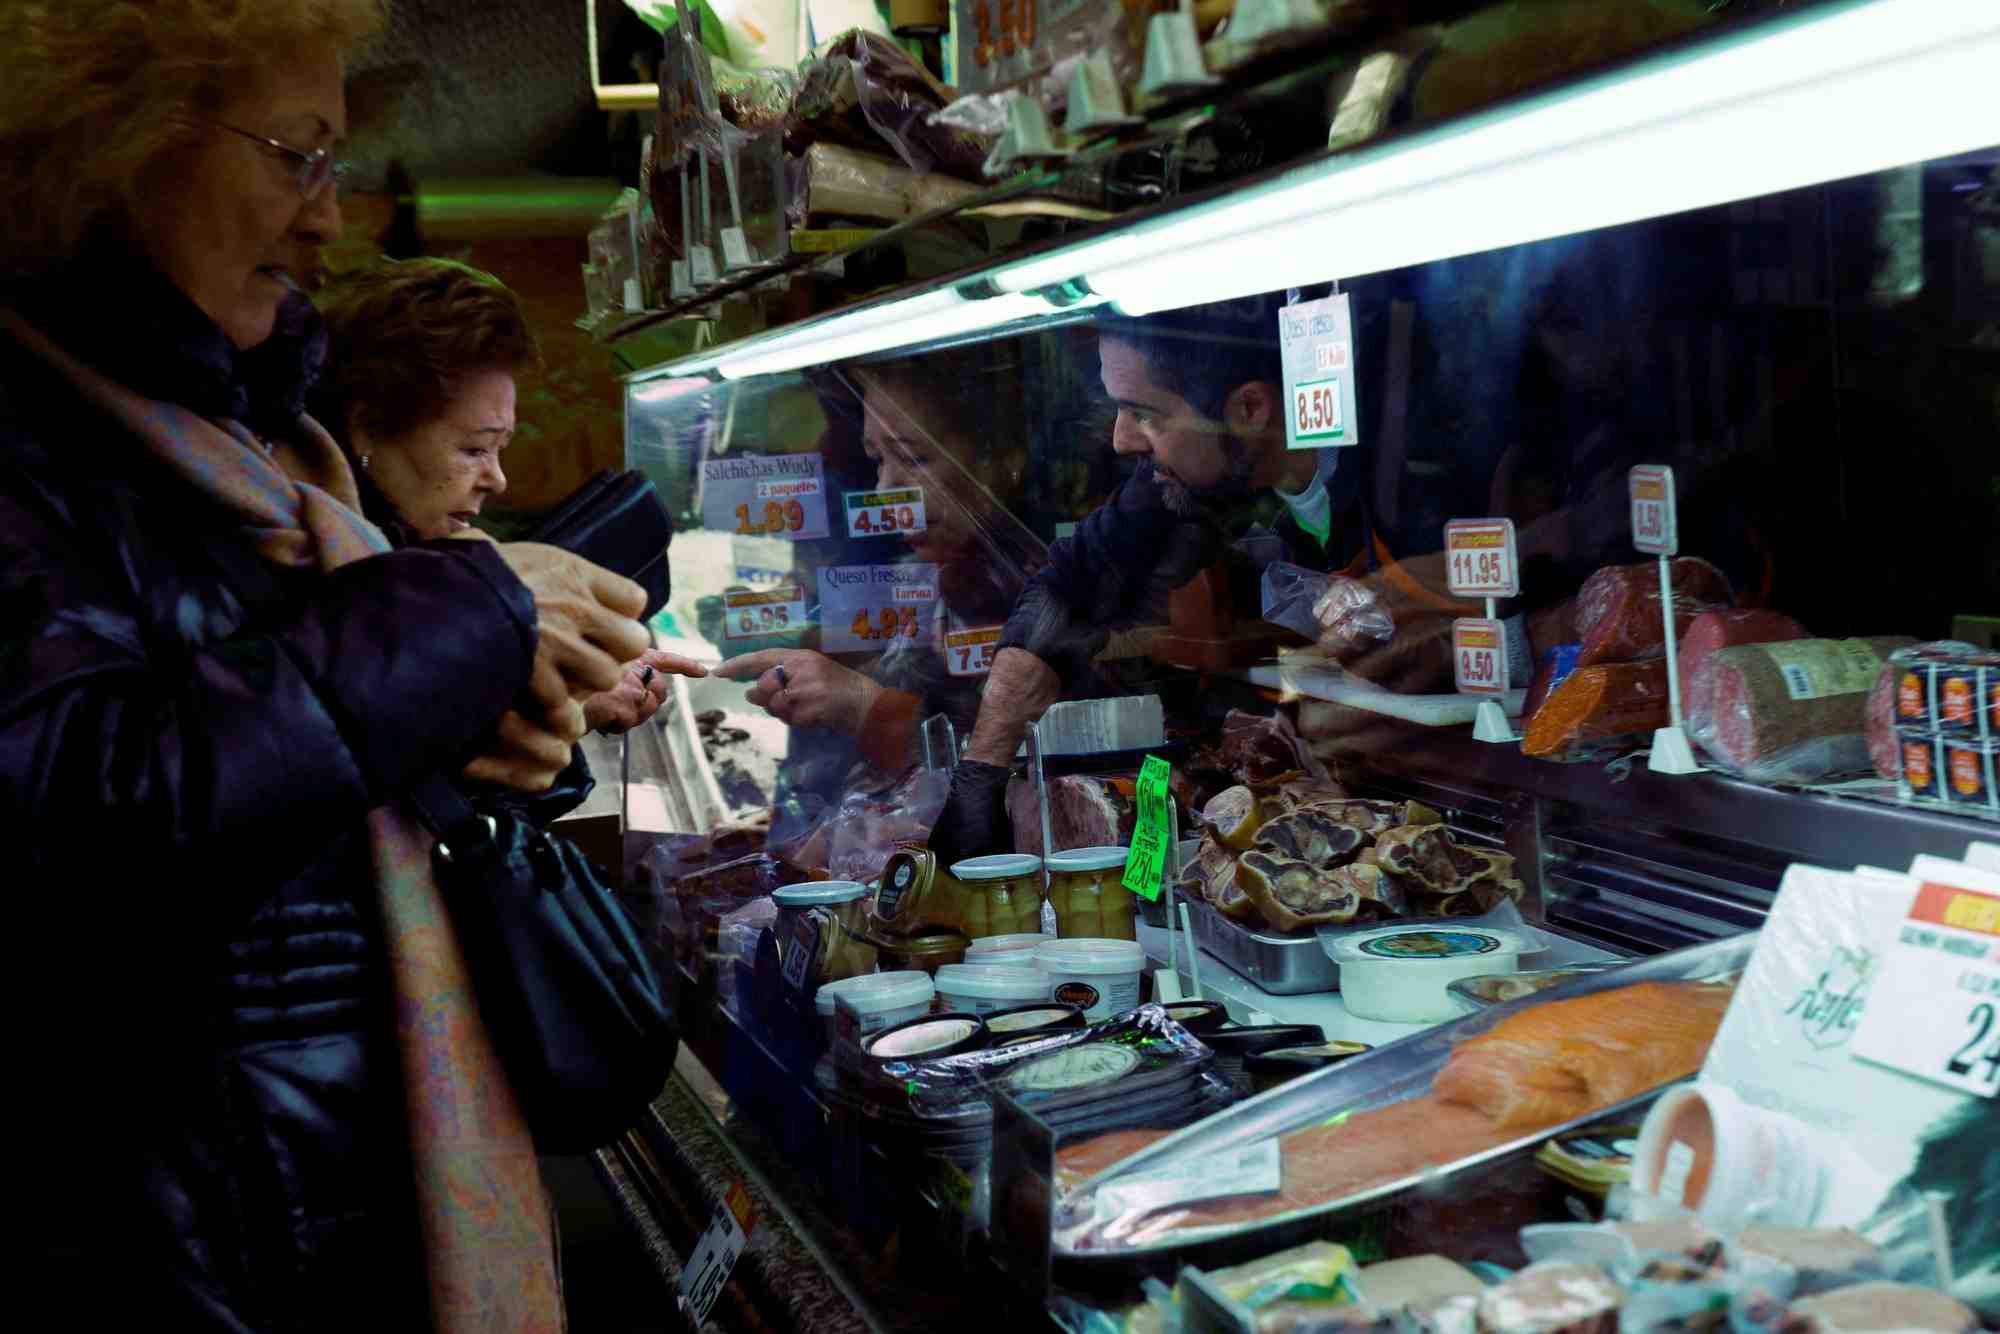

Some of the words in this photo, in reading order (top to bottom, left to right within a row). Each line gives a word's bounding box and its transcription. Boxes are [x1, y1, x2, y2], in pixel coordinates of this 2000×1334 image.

[1298, 387, 1334, 430] 8.50
[705, 458, 773, 481] Salchichas
[854, 505, 914, 533] 4.50
[825, 566, 866, 589] Queso
[1454, 552, 1501, 584] 11.95
